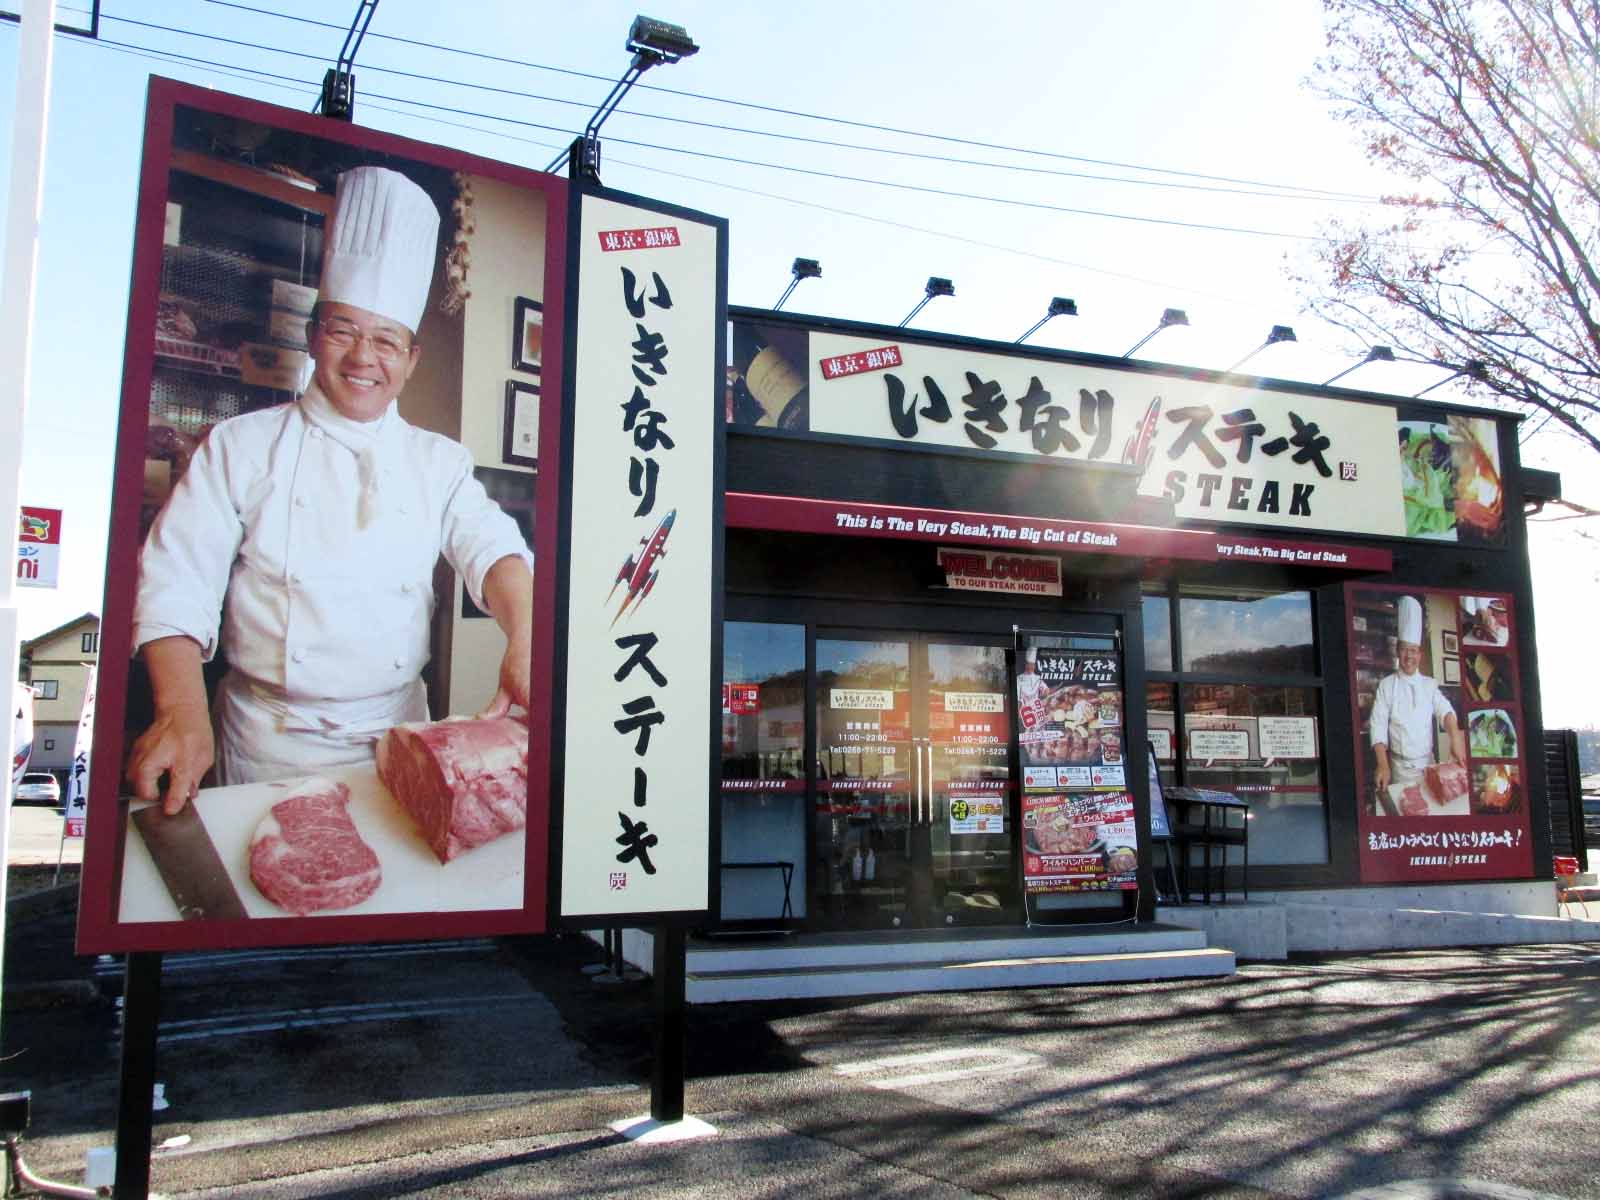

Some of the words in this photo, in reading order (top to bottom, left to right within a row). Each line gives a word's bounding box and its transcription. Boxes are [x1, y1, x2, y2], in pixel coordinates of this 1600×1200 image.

[605, 230, 676, 249] 東京・銀座
[828, 349, 898, 375] 東京・銀座
[620, 266, 675, 518] いきなり
[884, 371, 1114, 459] いきなり
[1165, 406, 1333, 478] ステーキ
[1163, 470, 1315, 517] STEAK
[836, 513, 868, 528] This
[870, 516, 883, 530] is
[887, 517, 914, 532] The
[917, 519, 948, 536] Very
[1019, 527, 1041, 543] Big
[1043, 529, 1064, 542] Cut
[1067, 530, 1080, 543] of
[1082, 531, 1118, 546] Steak
[942, 553, 1058, 582] WELCOME
[1280, 549, 1295, 560] Big
[1296, 550, 1311, 560] Cut
[1312, 551, 1321, 560] of
[1323, 551, 1347, 563] Steak
[954, 578, 966, 586] TO
[968, 579, 987, 588] OUR
[989, 581, 1017, 590] STEAK
[1018, 583, 1046, 592] HOUSE
[1037, 658, 1075, 673] いきなり
[1082, 659, 1117, 673] ステーキ
[613, 632, 668, 875] ステーキ
[1410, 856, 1447, 866] IKINARI
[1454, 855, 1487, 864] STEAK
